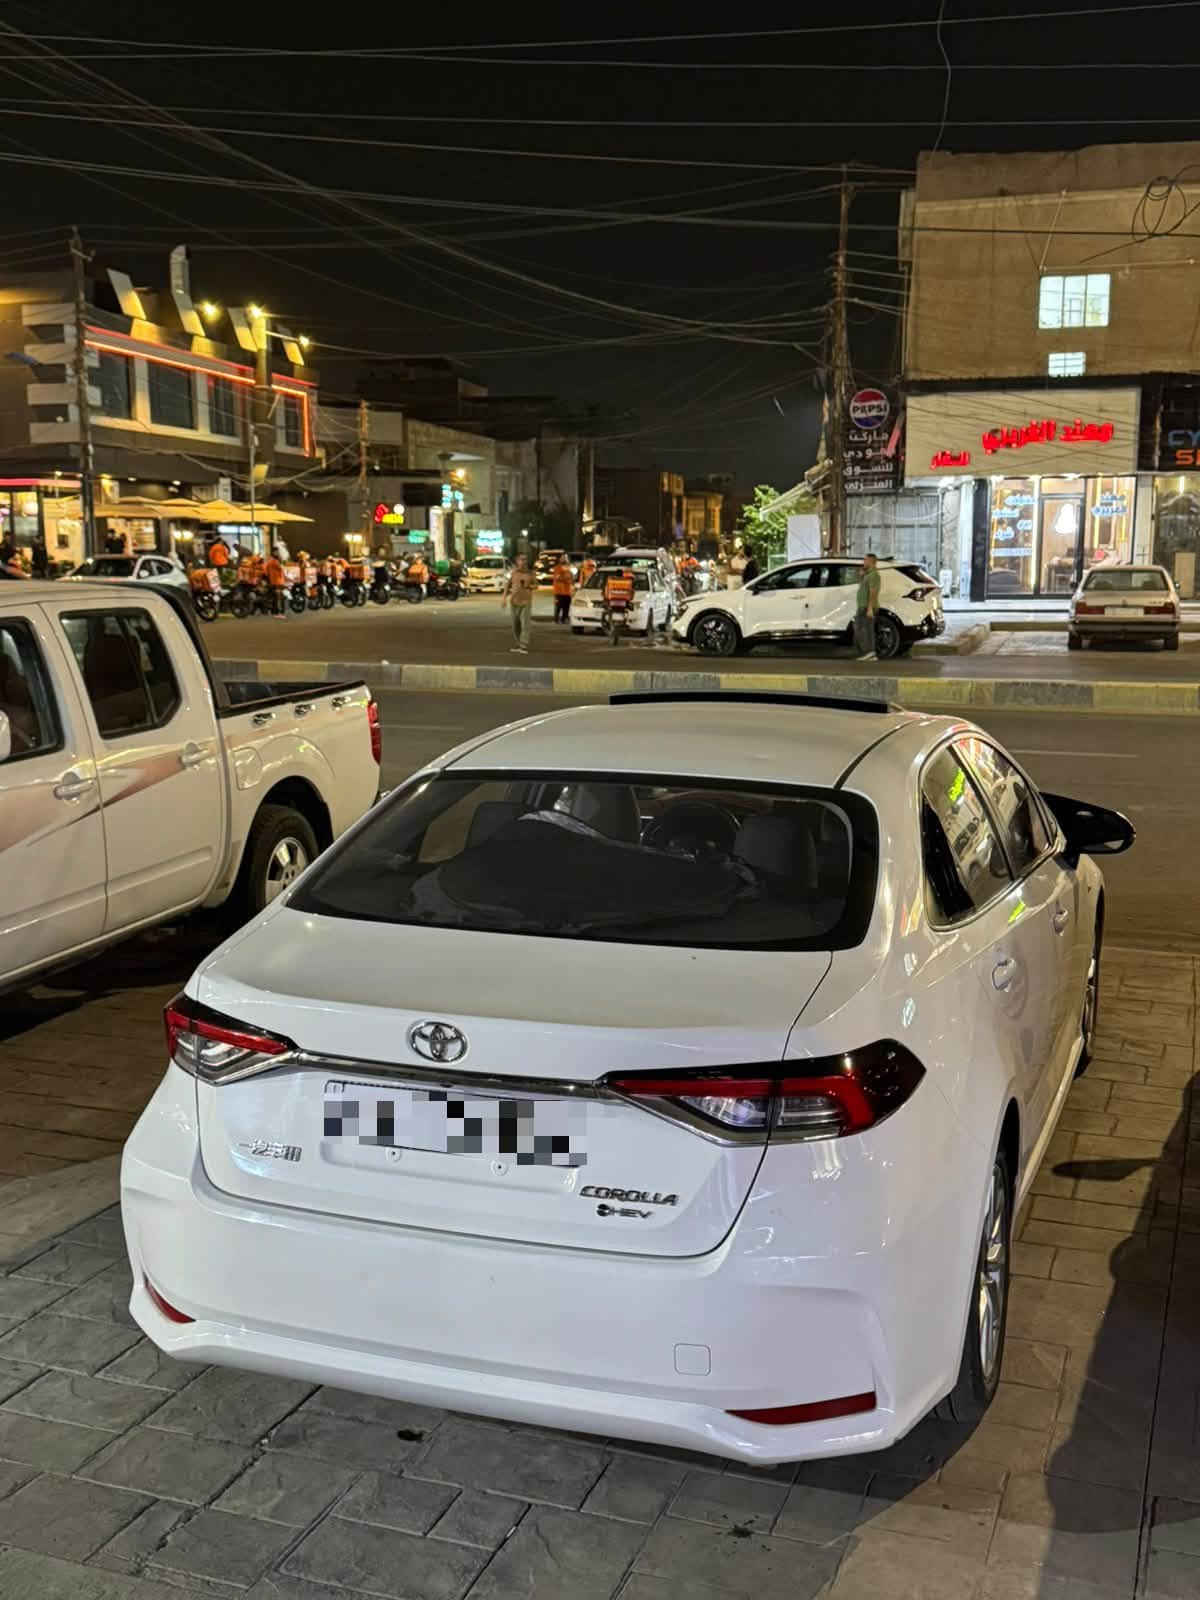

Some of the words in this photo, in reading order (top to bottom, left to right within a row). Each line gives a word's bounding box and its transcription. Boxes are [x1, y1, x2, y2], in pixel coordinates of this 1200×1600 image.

[853, 404, 887, 414] PEPSI
[849, 430, 889, 444] ماركت
[1176, 450, 1200, 466] S
[579, 1185, 678, 1206] COROLLA
